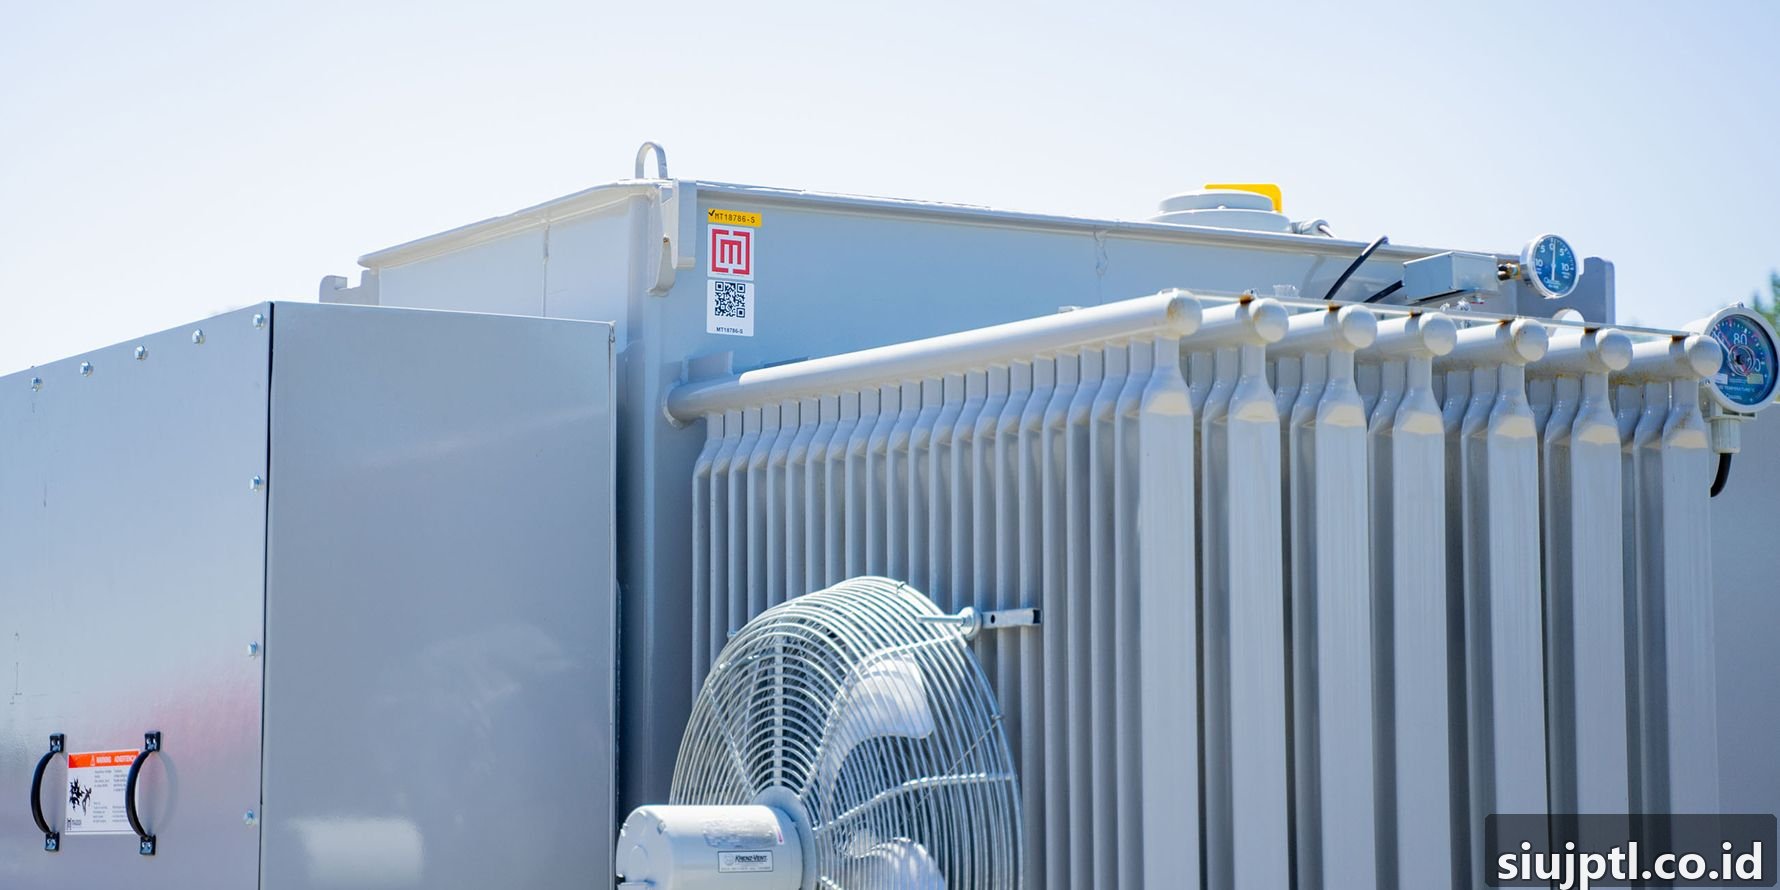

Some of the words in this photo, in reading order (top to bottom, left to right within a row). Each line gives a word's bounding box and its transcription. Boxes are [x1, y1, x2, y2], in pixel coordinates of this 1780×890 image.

[714, 212, 756, 224] MT18786-S
[1561, 262, 1570, 271] 10
[716, 326, 744, 334] MT18786-S
[1733, 332, 1748, 345] 80
